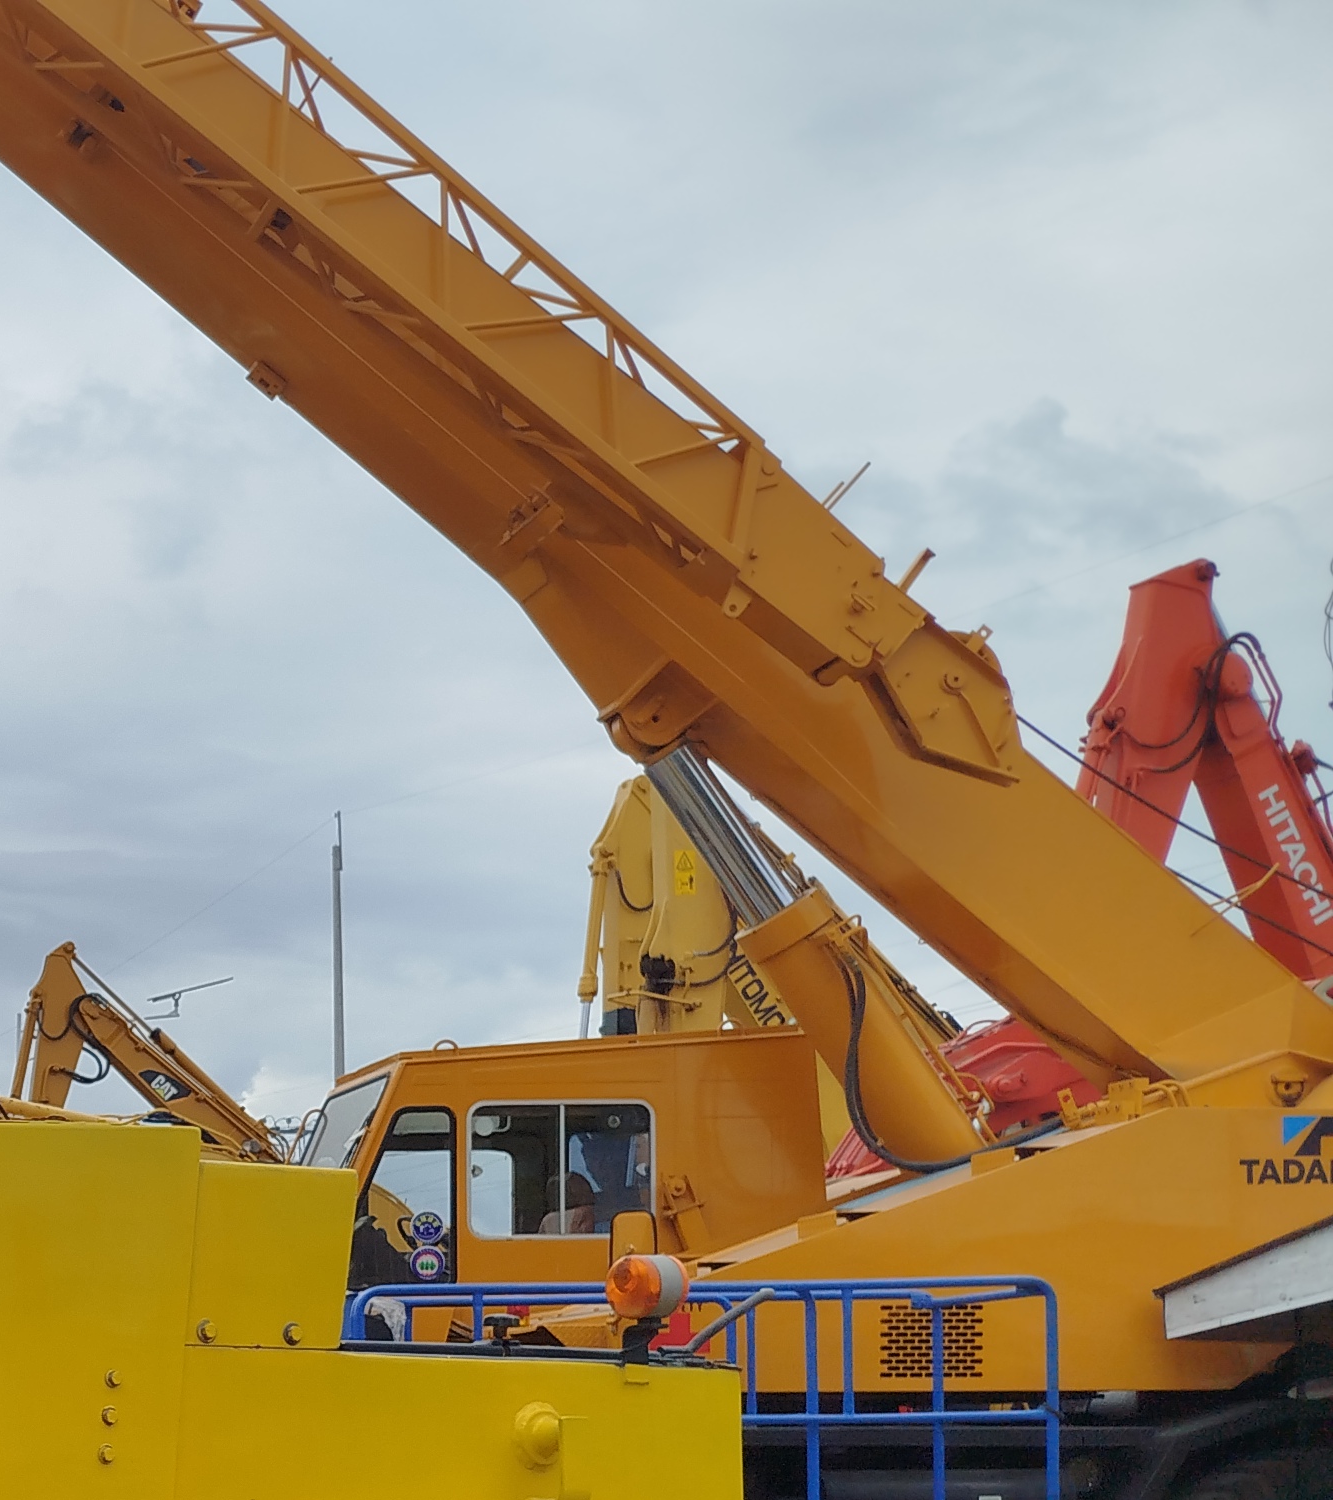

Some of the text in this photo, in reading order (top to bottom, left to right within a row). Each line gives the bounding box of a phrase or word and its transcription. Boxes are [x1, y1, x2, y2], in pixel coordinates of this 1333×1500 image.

[1258, 784, 1333, 926] HITACHI
[151, 1074, 179, 1101] CAT
[1239, 1158, 1333, 1185] TADA
